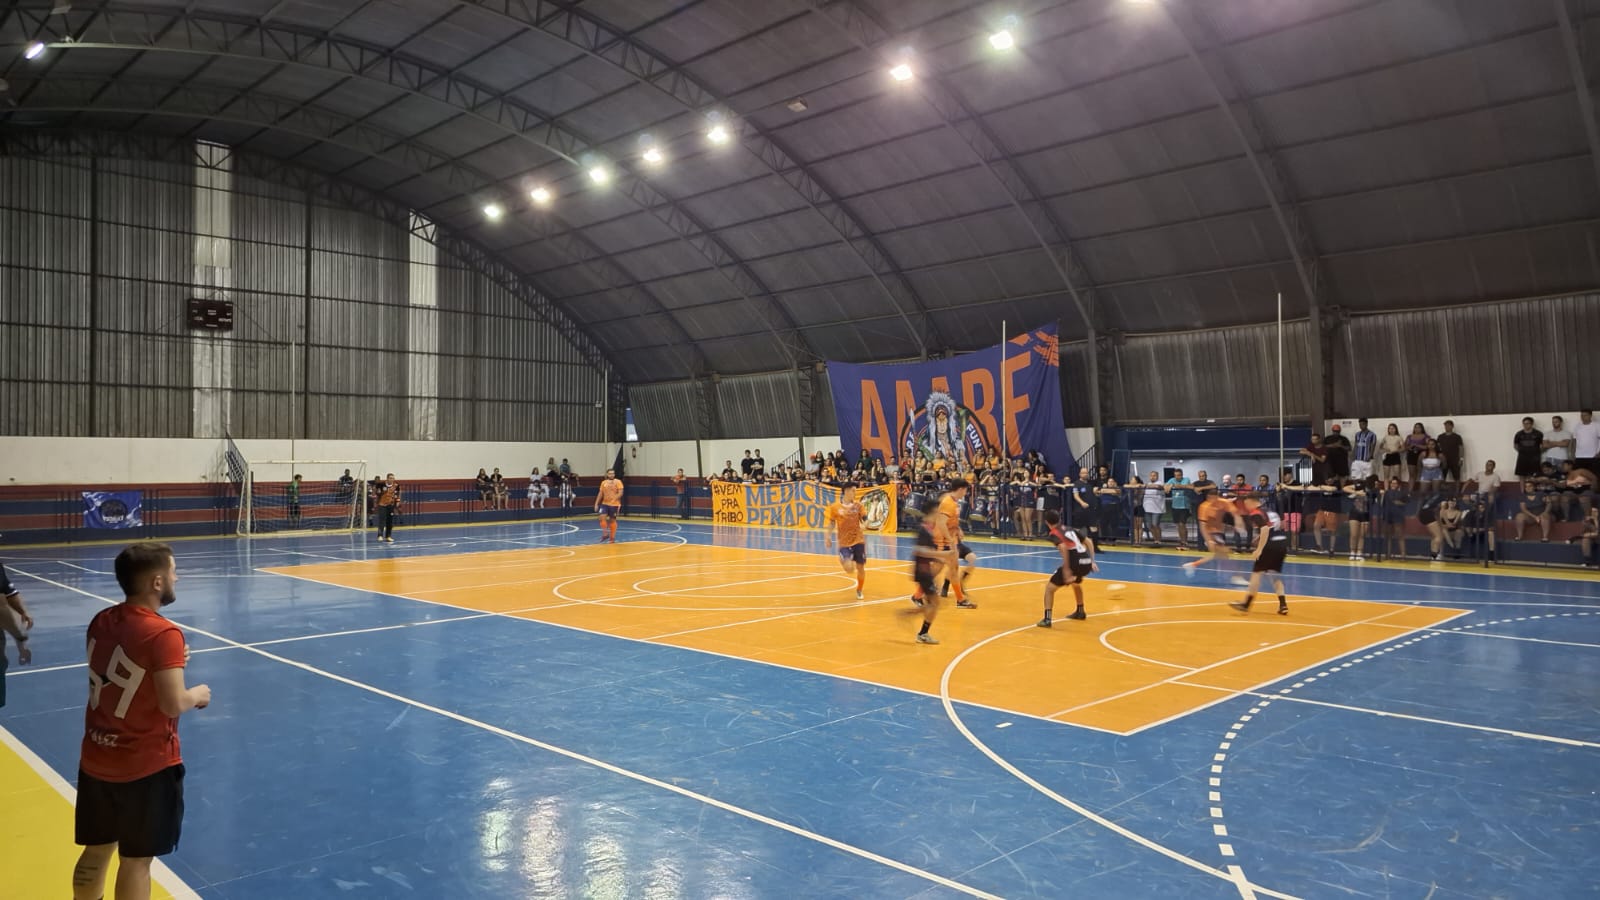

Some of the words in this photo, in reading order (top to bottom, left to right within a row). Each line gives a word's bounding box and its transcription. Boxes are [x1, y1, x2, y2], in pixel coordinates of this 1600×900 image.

[714, 484, 743, 495] #VEM
[746, 481, 838, 506] MEDICIN
[721, 498, 740, 509] PRA
[715, 510, 744, 523] TRIBO
